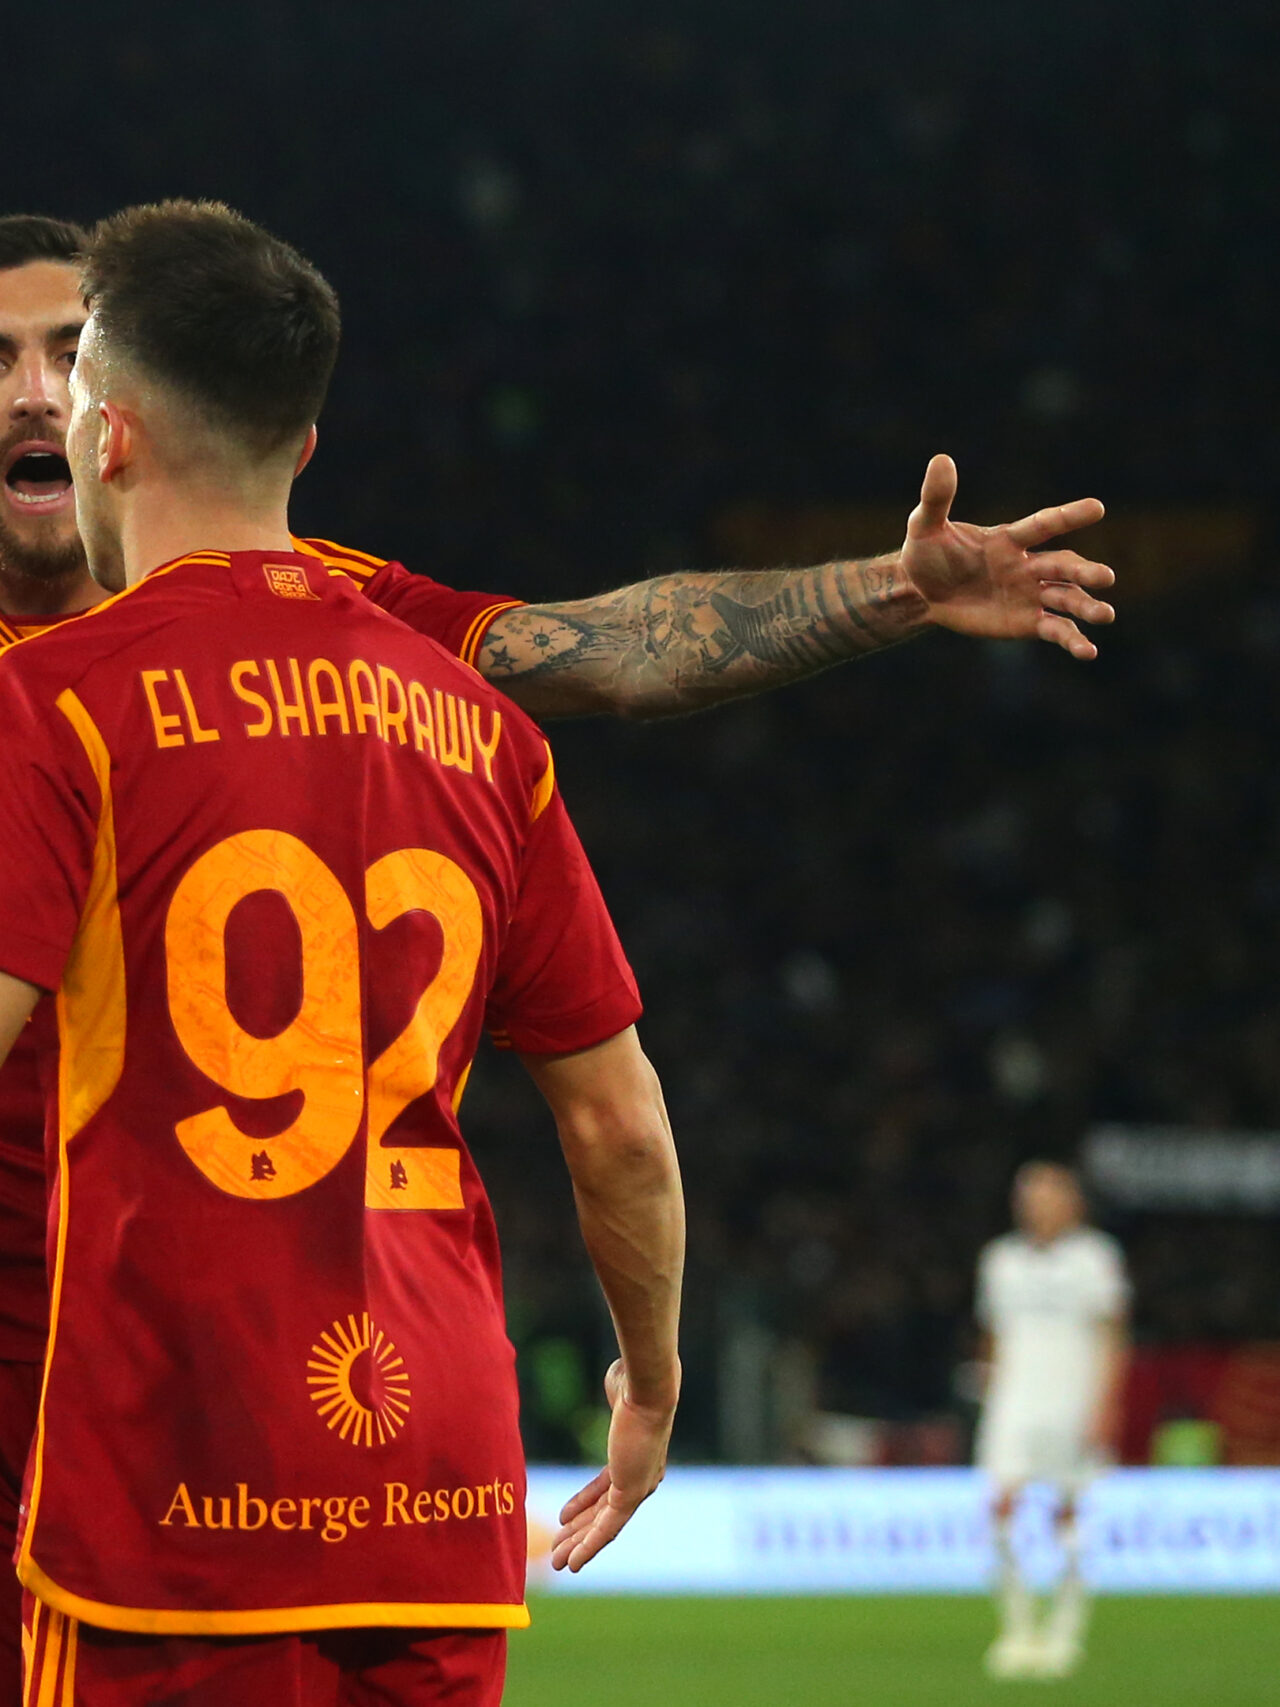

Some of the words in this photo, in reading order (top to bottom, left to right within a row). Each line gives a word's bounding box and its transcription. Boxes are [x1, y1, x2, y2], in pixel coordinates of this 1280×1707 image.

[141, 668, 220, 749] EL
[230, 657, 502, 783] SHAARAWY
[165, 828, 483, 1210] 92
[159, 1482, 370, 1543] Auberge
[382, 1475, 514, 1527] Resorts
